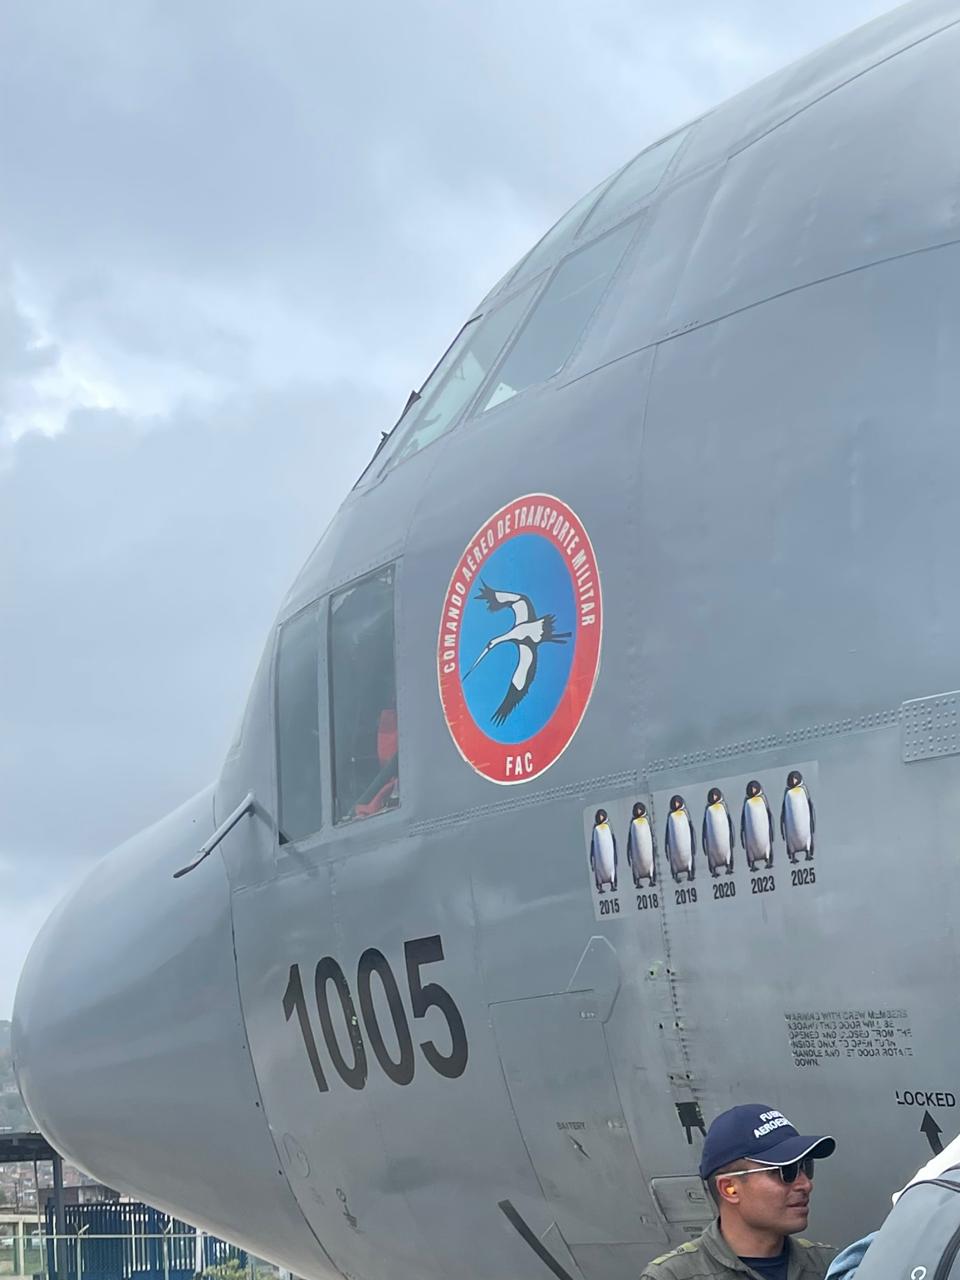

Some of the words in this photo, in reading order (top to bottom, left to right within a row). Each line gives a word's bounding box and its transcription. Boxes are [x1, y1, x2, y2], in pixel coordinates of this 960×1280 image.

[444, 582, 466, 673] COMANDO
[497, 514, 511, 540] DE
[514, 505, 579, 555] TRANSPORTE
[571, 549, 595, 626] MILITAR
[505, 752, 534, 777] FAC
[600, 898, 620, 915] 2015
[637, 894, 659, 910] 2018
[675, 887, 697, 905] 2019
[713, 881, 736, 900] 2020
[751, 875, 775, 894] 2023
[791, 868, 816, 886] 2025
[282, 934, 469, 1092] 1005
[858, 1048, 880, 1057] DOOR
[896, 1090, 956, 1107] LOCKED
